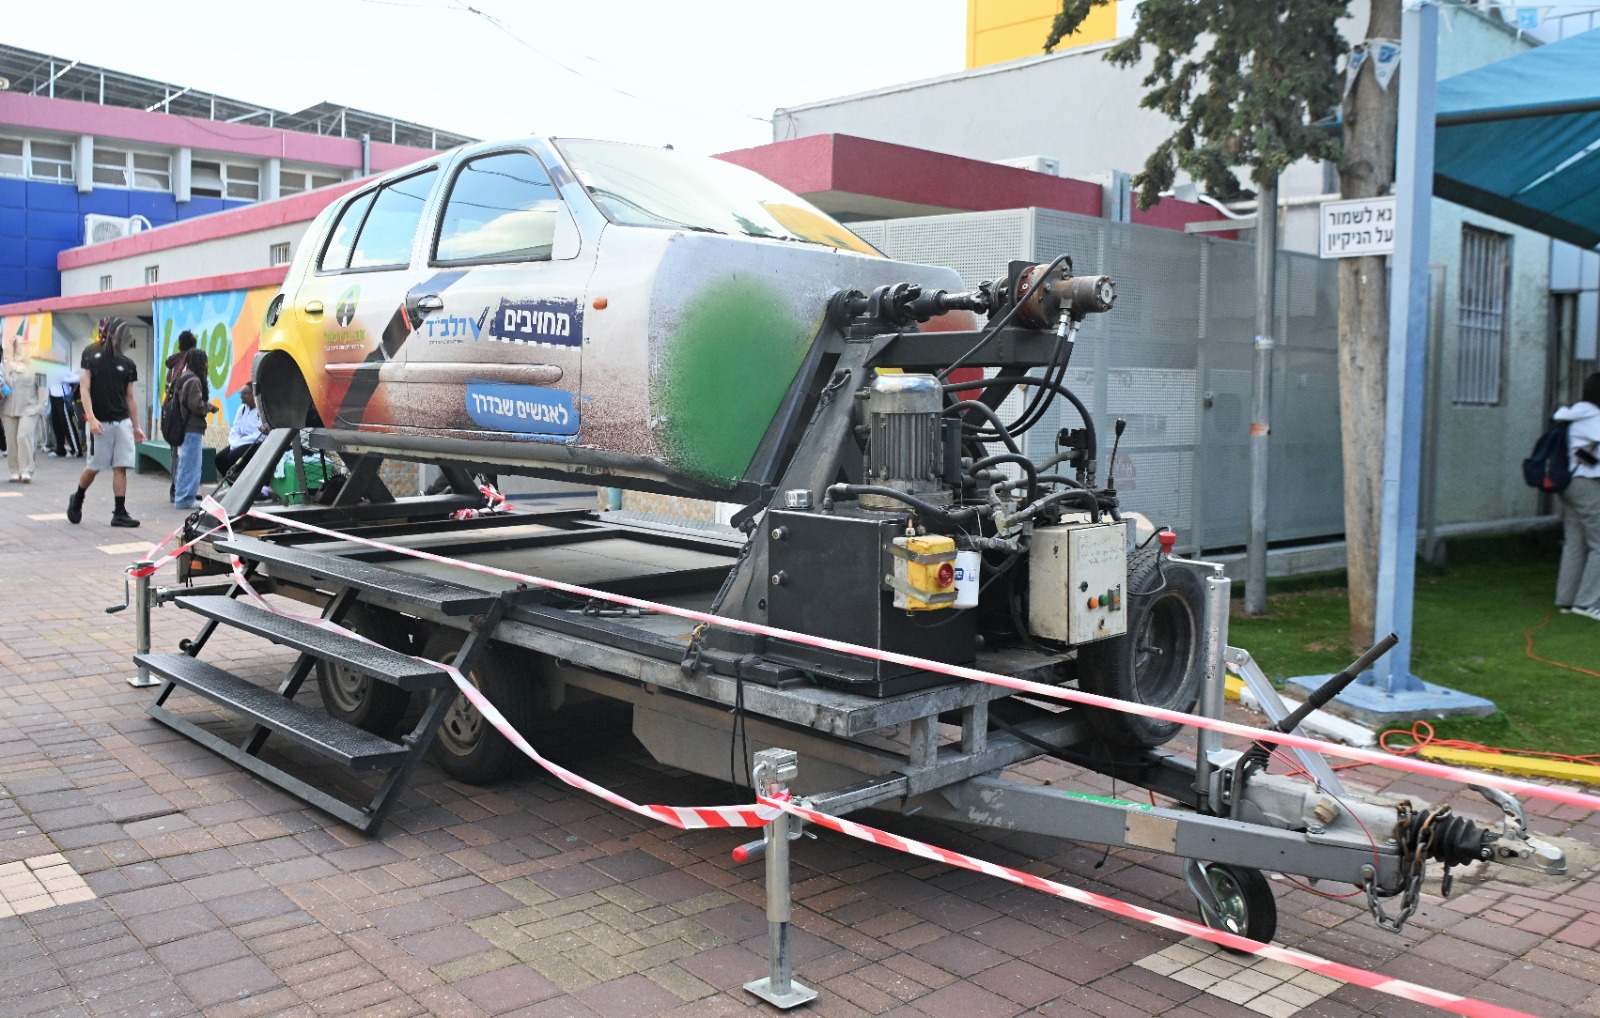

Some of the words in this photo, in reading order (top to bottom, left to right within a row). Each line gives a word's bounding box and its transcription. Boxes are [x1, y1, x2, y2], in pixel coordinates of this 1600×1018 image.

[1329, 207, 1372, 225] לשמור
[1377, 208, 1392, 222] נא
[1328, 230, 1372, 251] הניקיון
[1375, 227, 1393, 243] על
[504, 309, 570, 337] מחויבים
[158, 319, 231, 406] le
[471, 393, 514, 417] שבדרך
[516, 400, 568, 425] לאנשים
